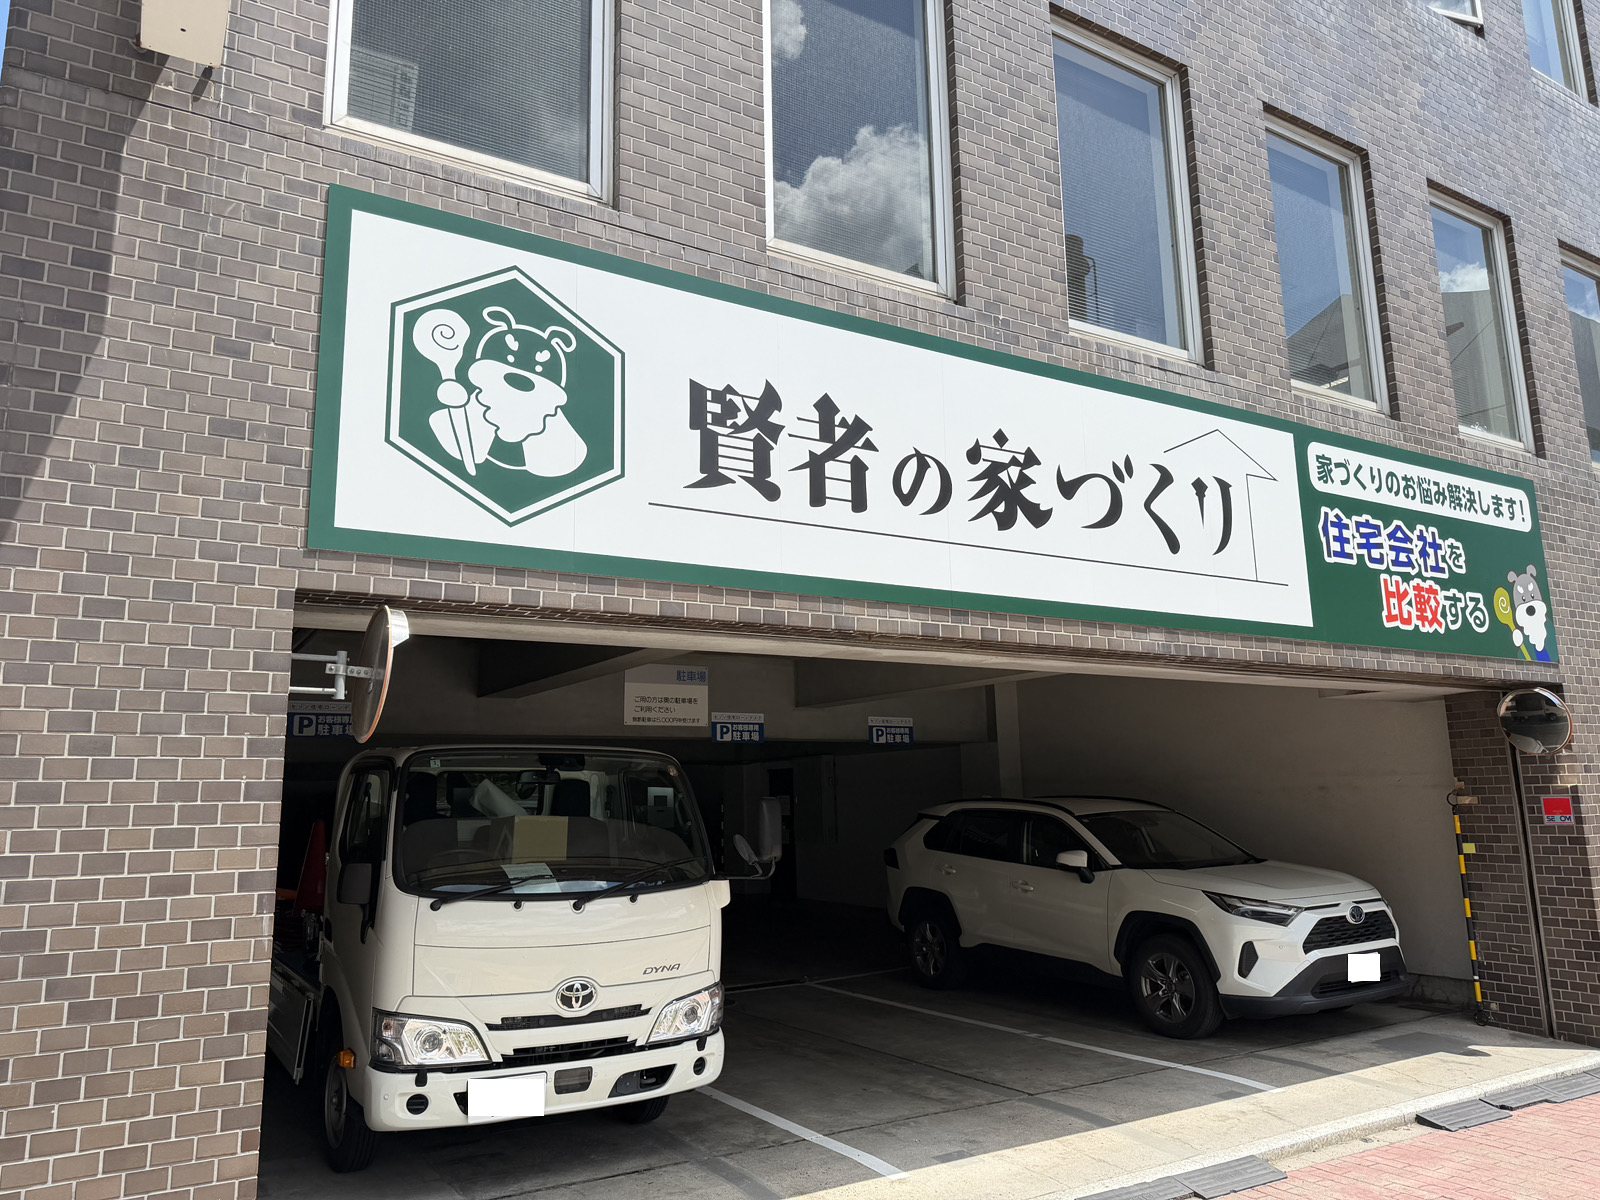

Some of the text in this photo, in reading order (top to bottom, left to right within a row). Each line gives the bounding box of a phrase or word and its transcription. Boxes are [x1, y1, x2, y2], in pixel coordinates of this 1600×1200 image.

[682, 378, 1233, 555] 賢者の家づくり
[1320, 508, 1465, 577] 住宅会社を
[1381, 575, 1488, 632] 比較する
[676, 669, 706, 683] 駐車場
[633, 705, 676, 714] ご利用ください
[298, 716, 314, 734] P
[317, 715, 352, 724] お客様専
[720, 725, 730, 740] P
[732, 731, 760, 742] 駐車場
[876, 729, 884, 742] P
[642, 962, 681, 975] DYNA
